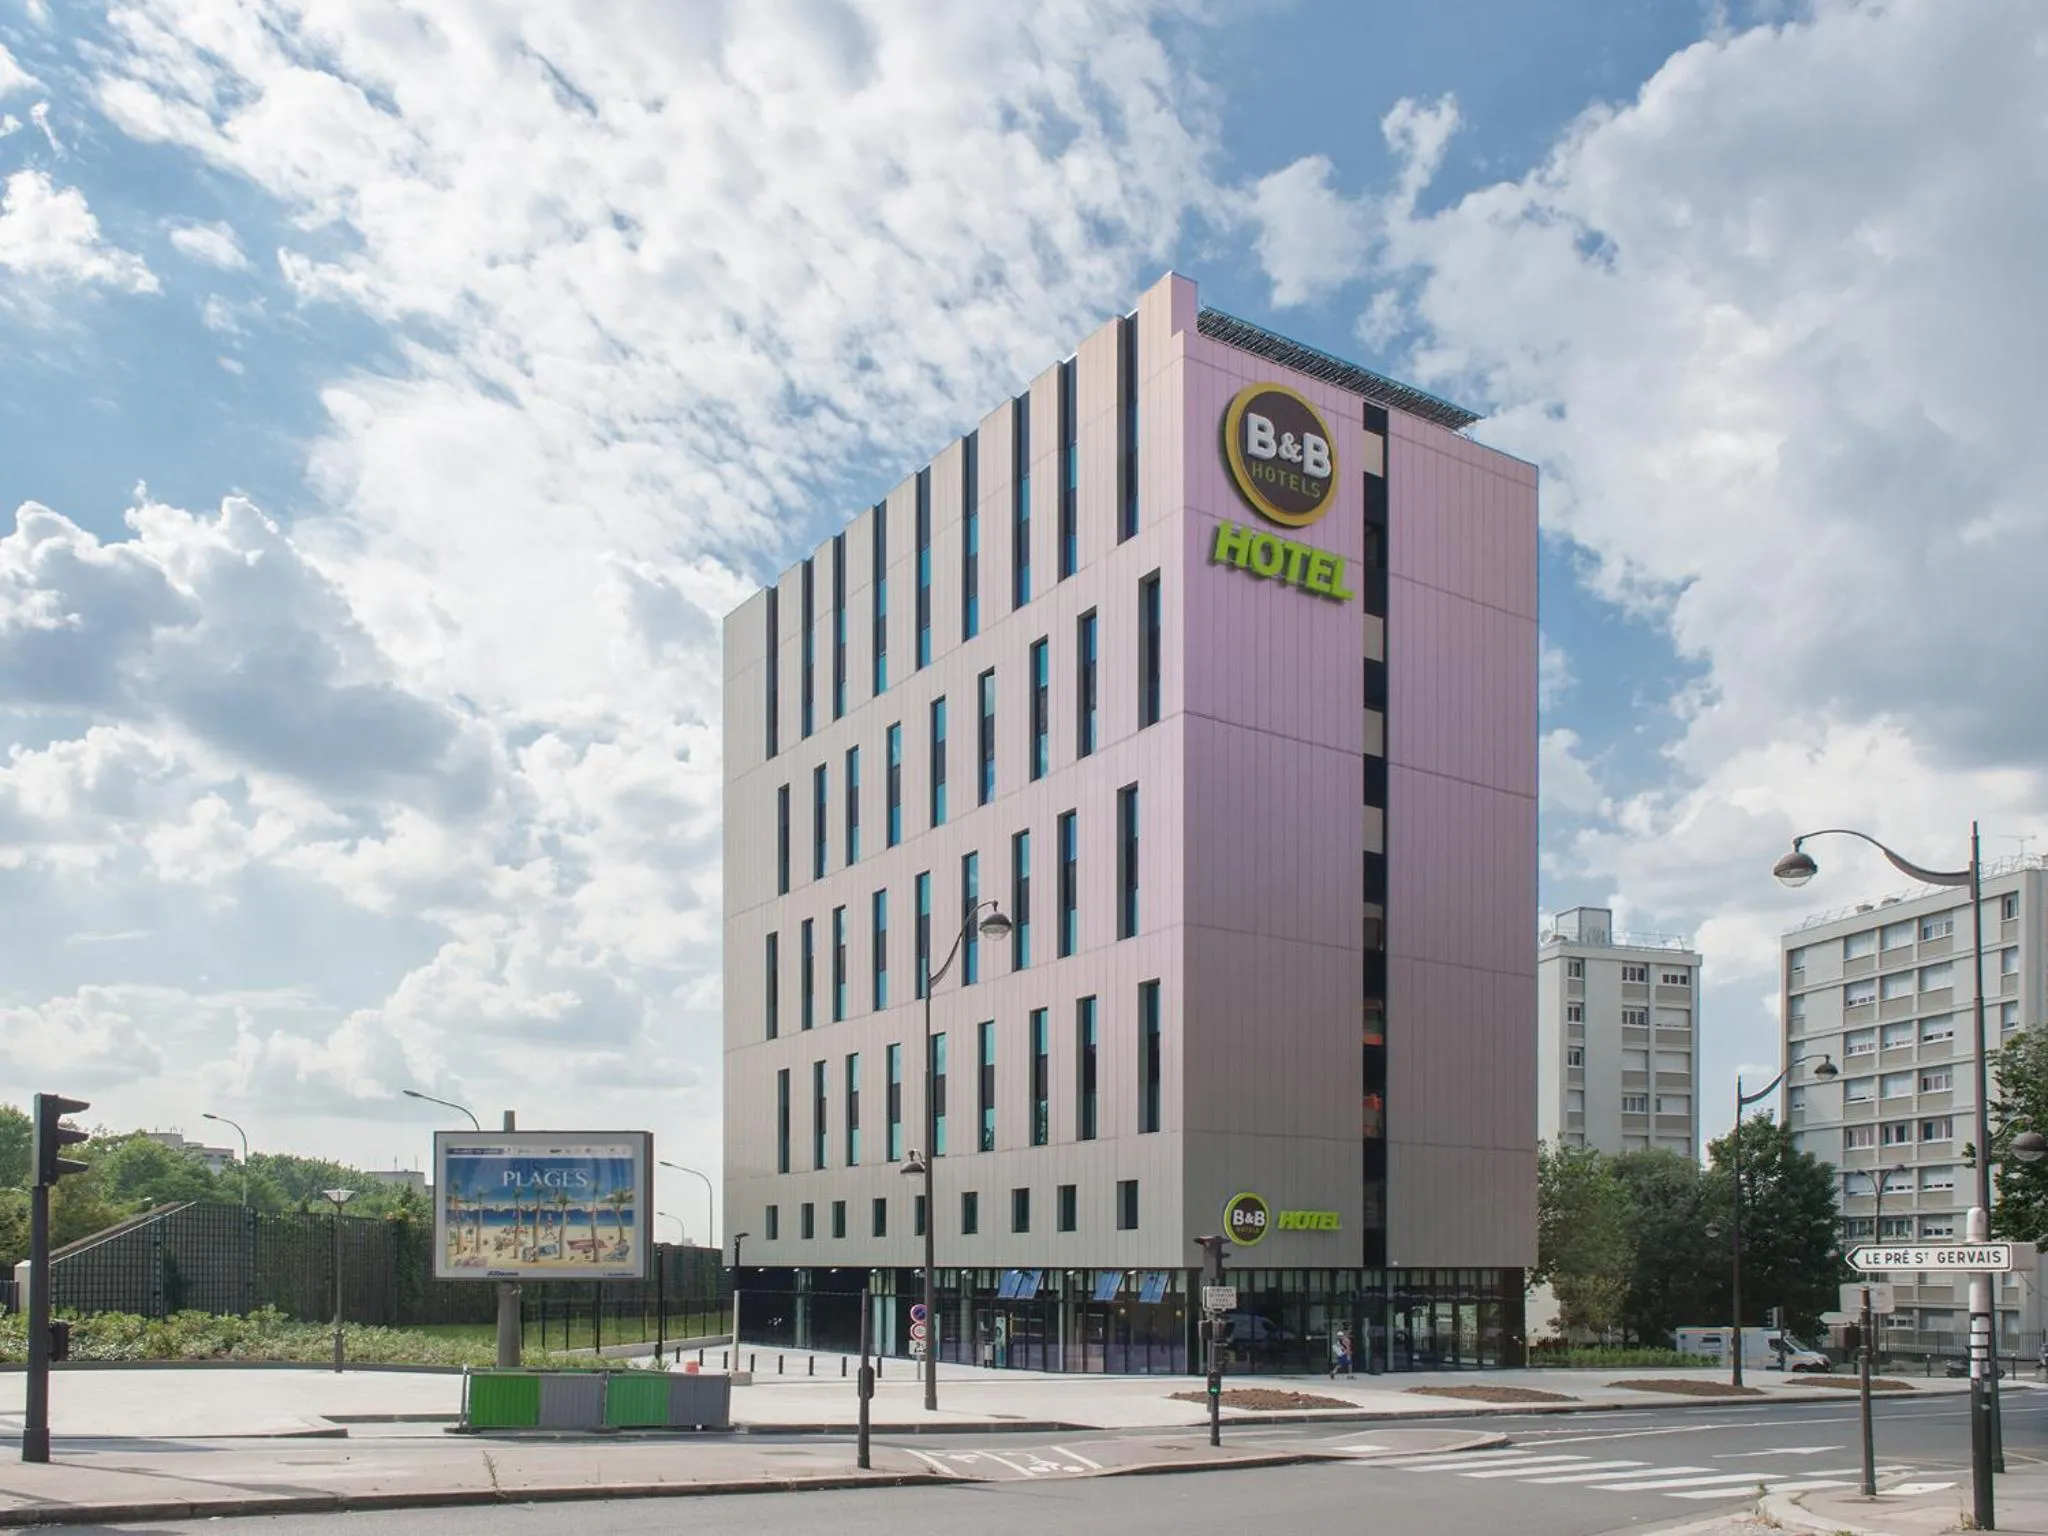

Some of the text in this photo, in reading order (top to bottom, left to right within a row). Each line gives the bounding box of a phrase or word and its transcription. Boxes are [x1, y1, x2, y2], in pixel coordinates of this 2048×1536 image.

[1247, 412, 1332, 479] B&B
[1252, 461, 1321, 498] HOTELS
[1214, 521, 1354, 600] HOTEL
[503, 1169, 589, 1187] PLAGES
[1233, 1209, 1265, 1227] B&B
[1278, 1210, 1342, 1230] HOTEL
[1865, 1253, 1880, 1264] LE
[1937, 1251, 2002, 1264] GERVAIS
